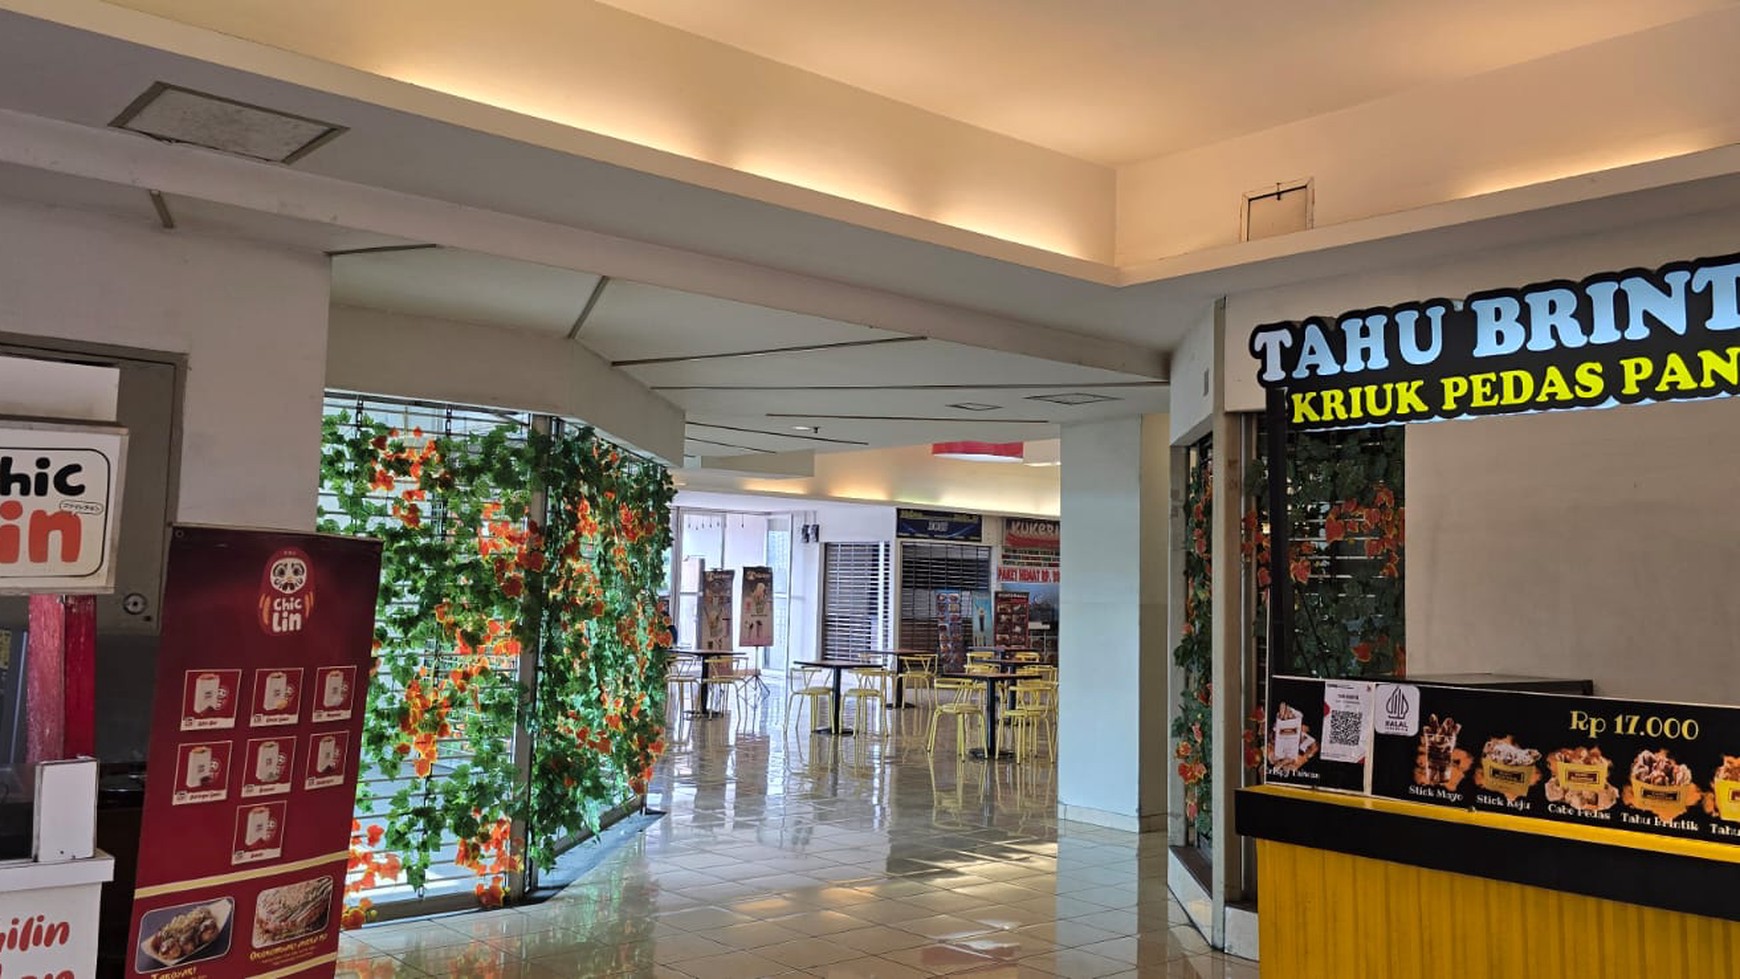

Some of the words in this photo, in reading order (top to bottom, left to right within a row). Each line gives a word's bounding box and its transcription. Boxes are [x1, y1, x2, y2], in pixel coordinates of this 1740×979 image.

[1254, 306, 1446, 381] TAHU
[1471, 263, 1740, 357] BRINT
[1291, 380, 1428, 423] KRIUK
[1441, 362, 1604, 410] PEDAS
[1620, 346, 1740, 394] PAN
[273, 597, 302, 611] Chic
[272, 611, 302, 632] Lin
[1569, 710, 1606, 739] Rp
[1614, 714, 1699, 741] 17.000
[1409, 785, 1435, 798] Stick
[1437, 789, 1463, 802] Mayo
[1476, 794, 1504, 807] Stick
[1548, 803, 1575, 816] Cabe
[1620, 812, 1651, 826] Tahu
